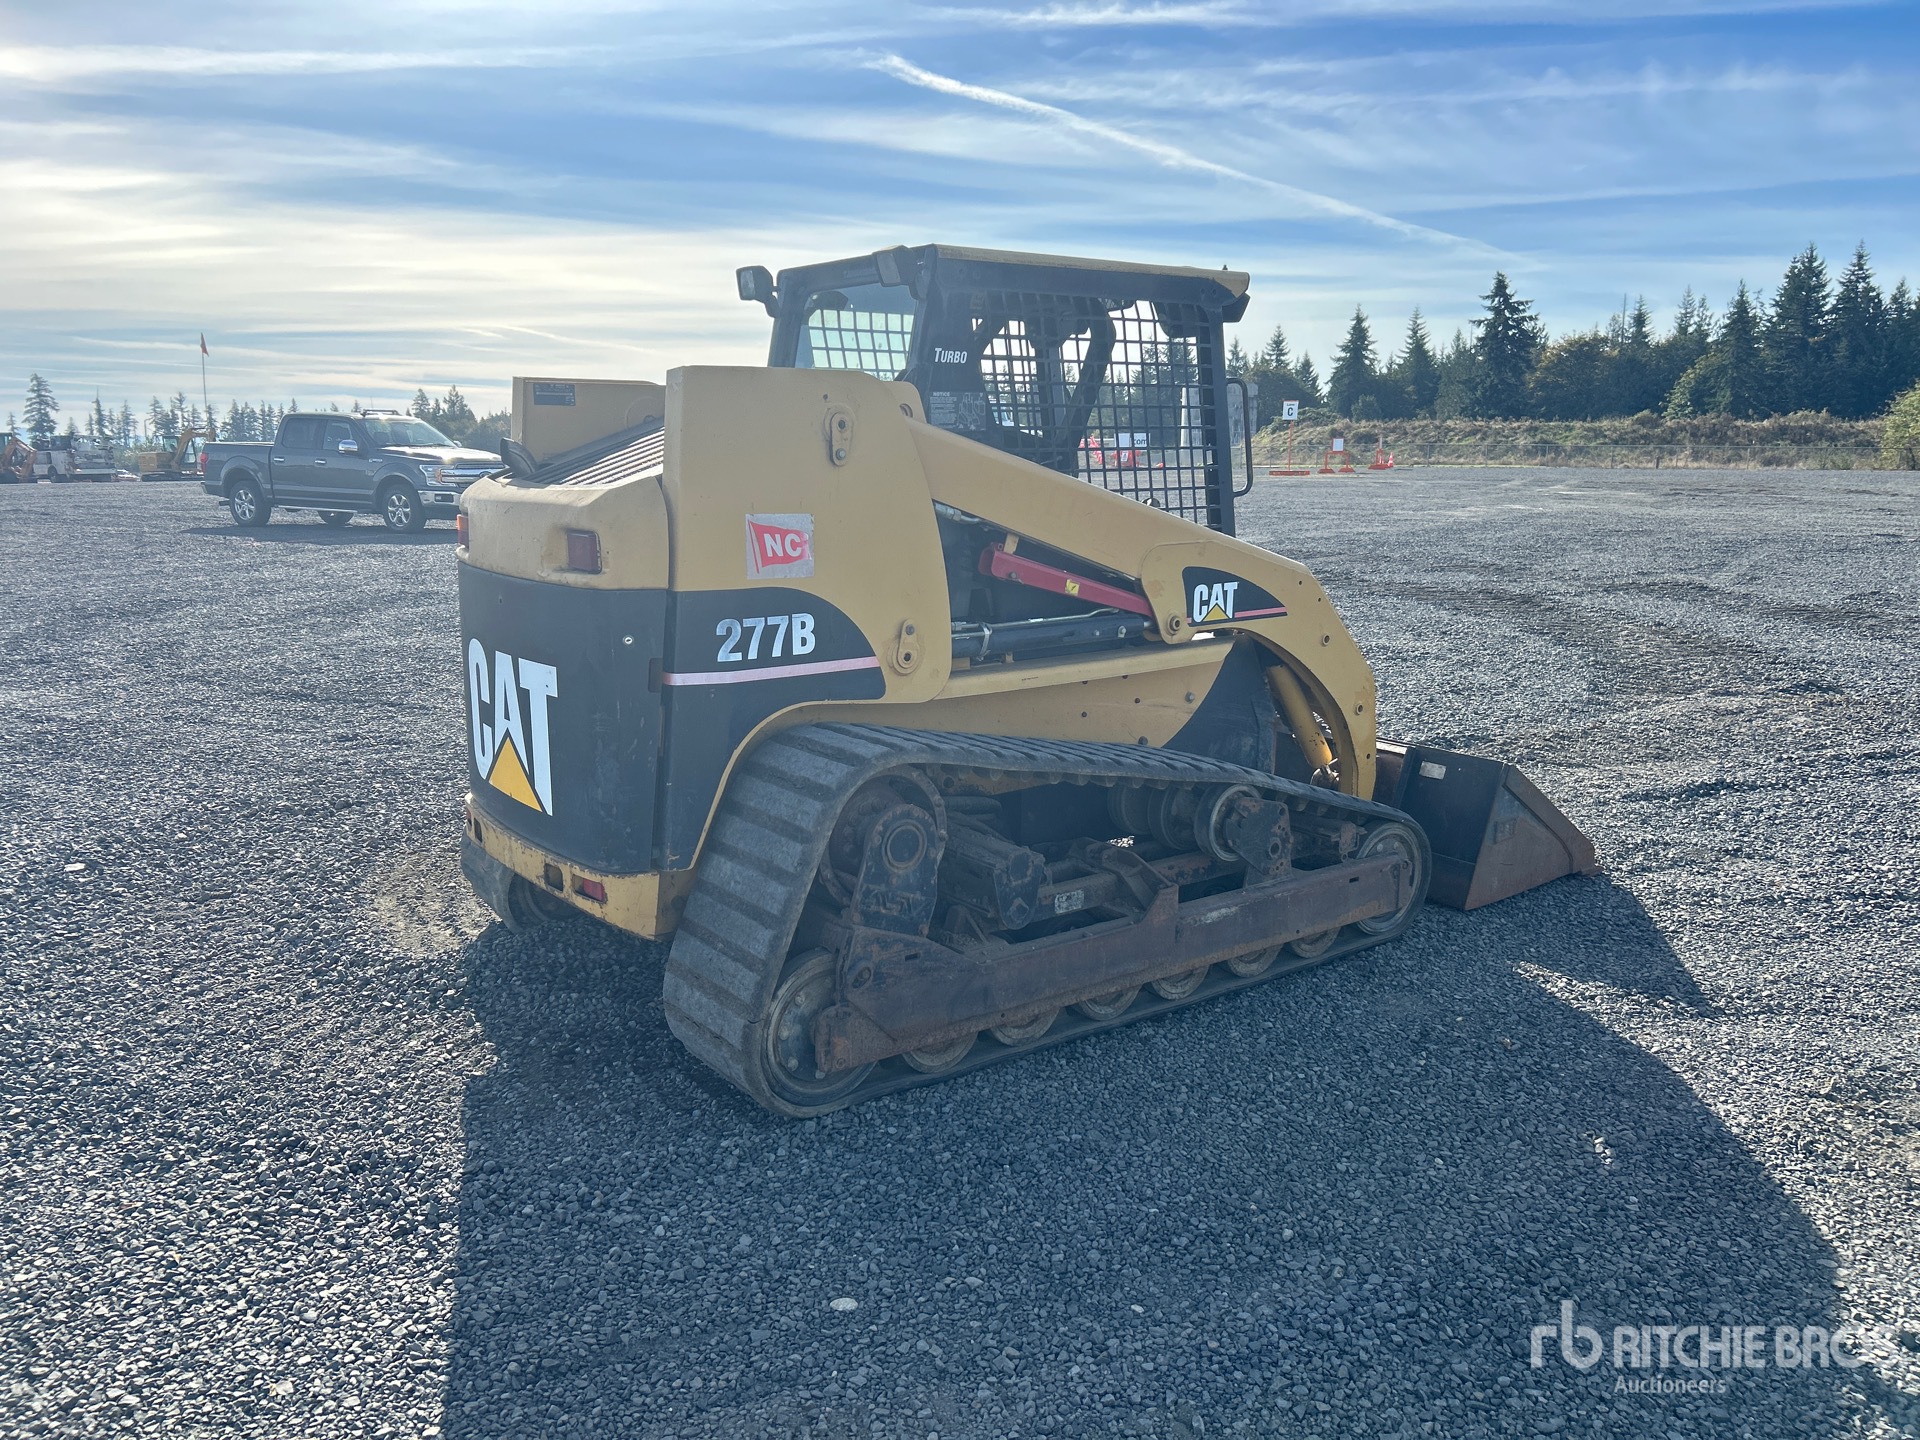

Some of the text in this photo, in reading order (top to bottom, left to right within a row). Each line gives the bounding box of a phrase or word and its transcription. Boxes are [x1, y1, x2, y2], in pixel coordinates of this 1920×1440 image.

[934, 347, 968, 364] TURBO
[1287, 407, 1294, 416] C
[763, 533, 803, 558] NC
[1192, 581, 1238, 623] CAT
[715, 612, 816, 663] 277B
[468, 638, 558, 816] CAT
